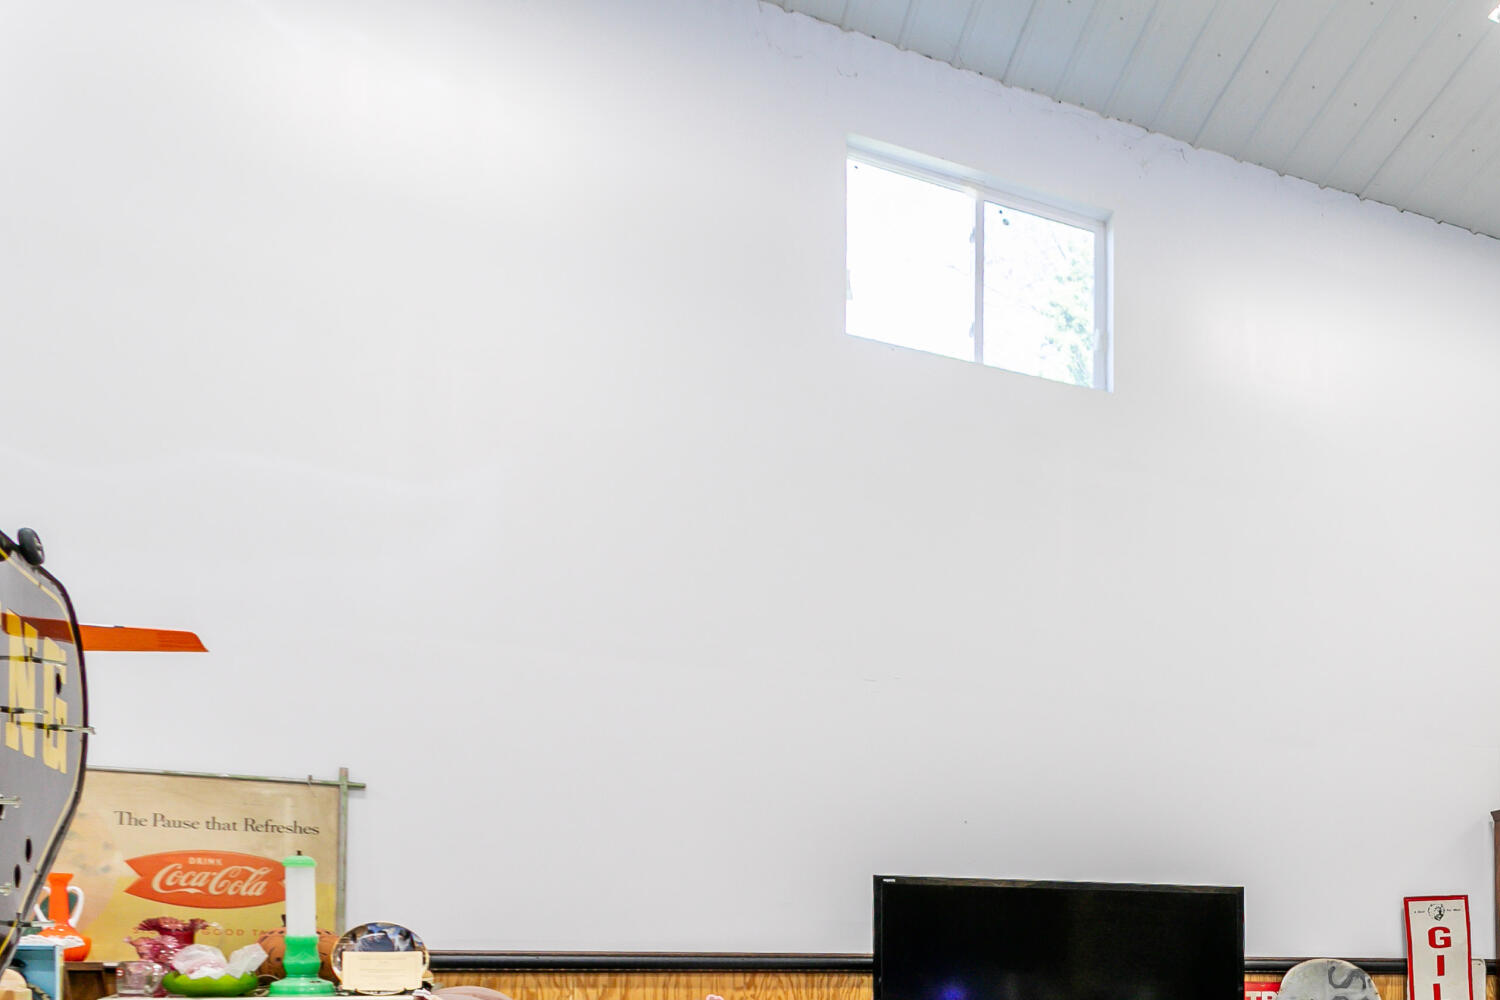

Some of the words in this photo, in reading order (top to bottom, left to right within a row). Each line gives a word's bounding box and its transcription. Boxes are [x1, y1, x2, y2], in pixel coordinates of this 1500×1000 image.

[114, 811, 148, 827] The
[152, 812, 200, 830] Pause
[205, 816, 237, 832] that
[243, 818, 320, 835] Refreshes
[188, 857, 223, 866] DRINK
[151, 863, 272, 896] Coca-Cola
[202, 928, 245, 937] GOOD
